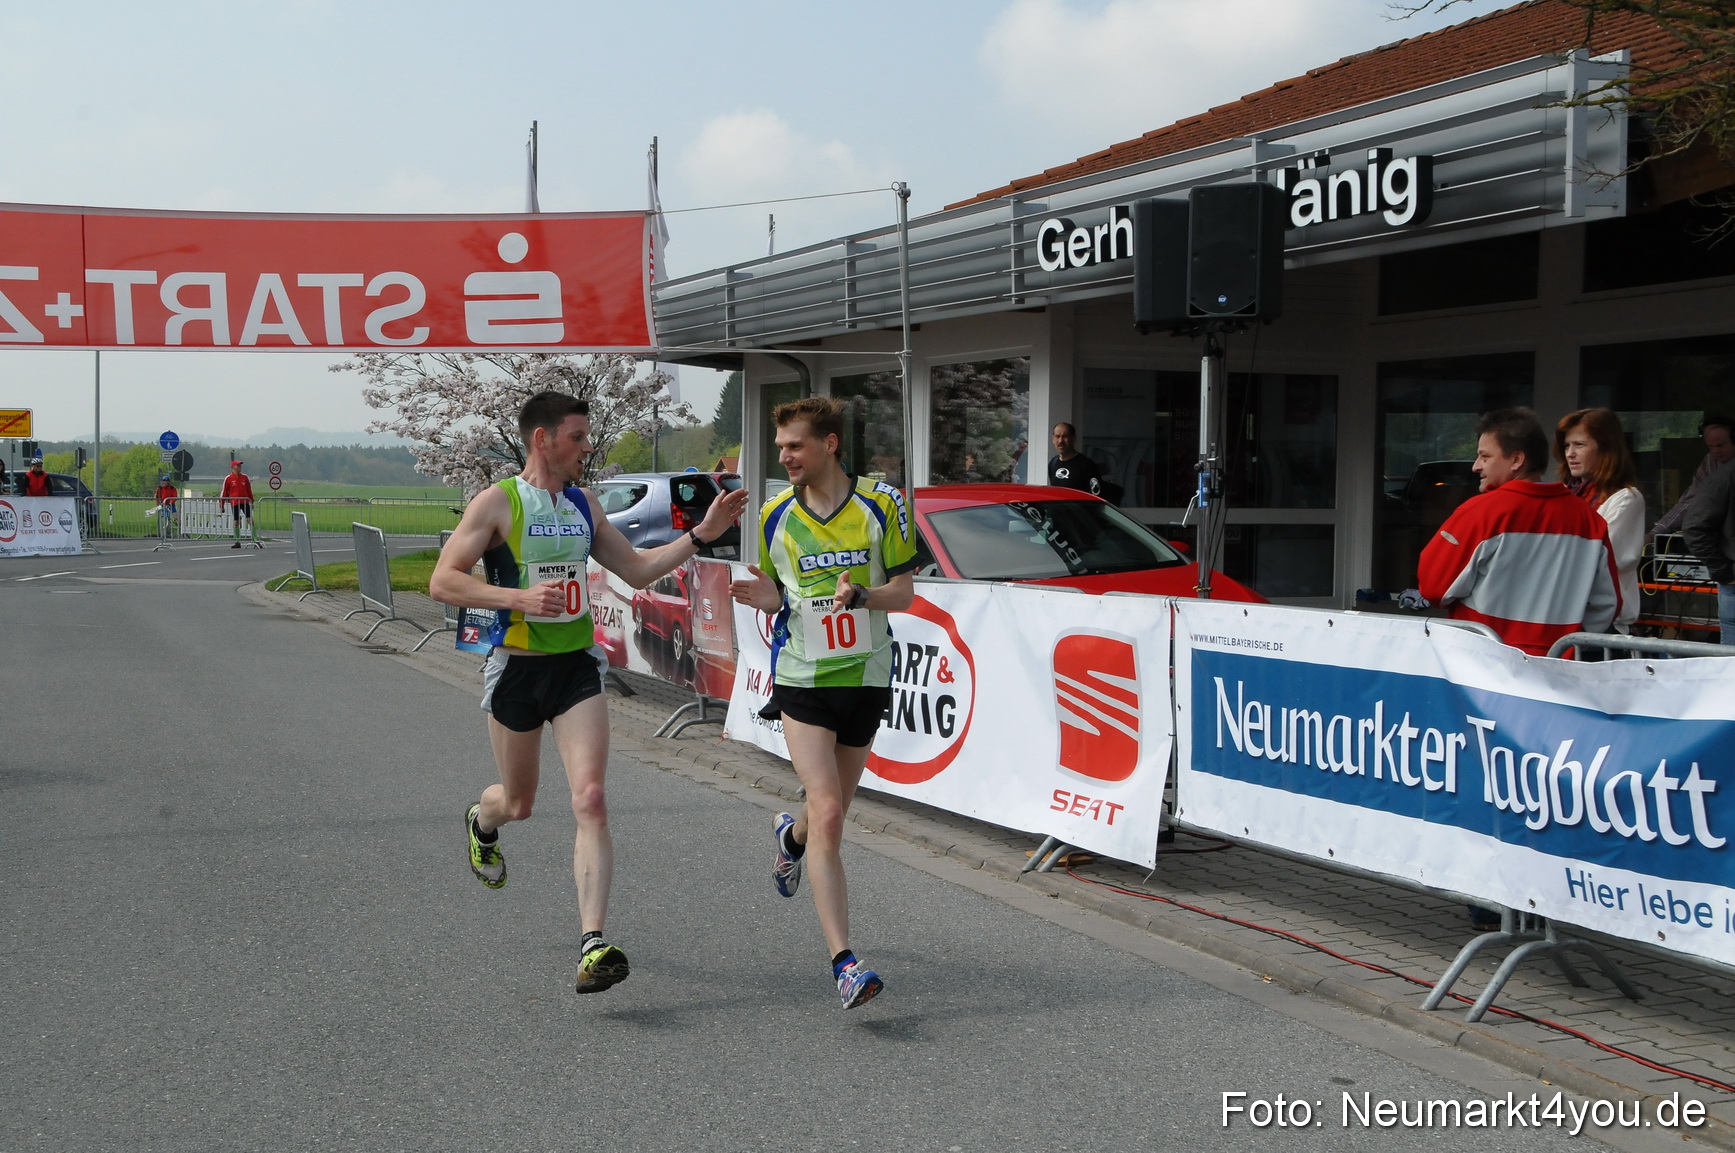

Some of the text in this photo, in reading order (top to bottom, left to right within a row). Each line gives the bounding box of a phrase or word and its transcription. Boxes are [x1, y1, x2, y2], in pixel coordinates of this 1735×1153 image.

[1037, 148, 1418, 272] Gerh änig
[529, 524, 585, 536] BOCK
[539, 566, 566, 574] MEYER
[798, 549, 871, 573] BOCK
[812, 599, 834, 607] MEY
[821, 612, 857, 650] 10
[1193, 633, 1284, 651] WWW.MITTELBAYERISCHE.DE
[937, 655, 955, 684] &
[1213, 676, 1727, 849] Neumarkter Tagblatt
[1049, 788, 1125, 826] SEAT
[1565, 867, 1630, 911] Hier
[1637, 882, 1714, 929] lebe
